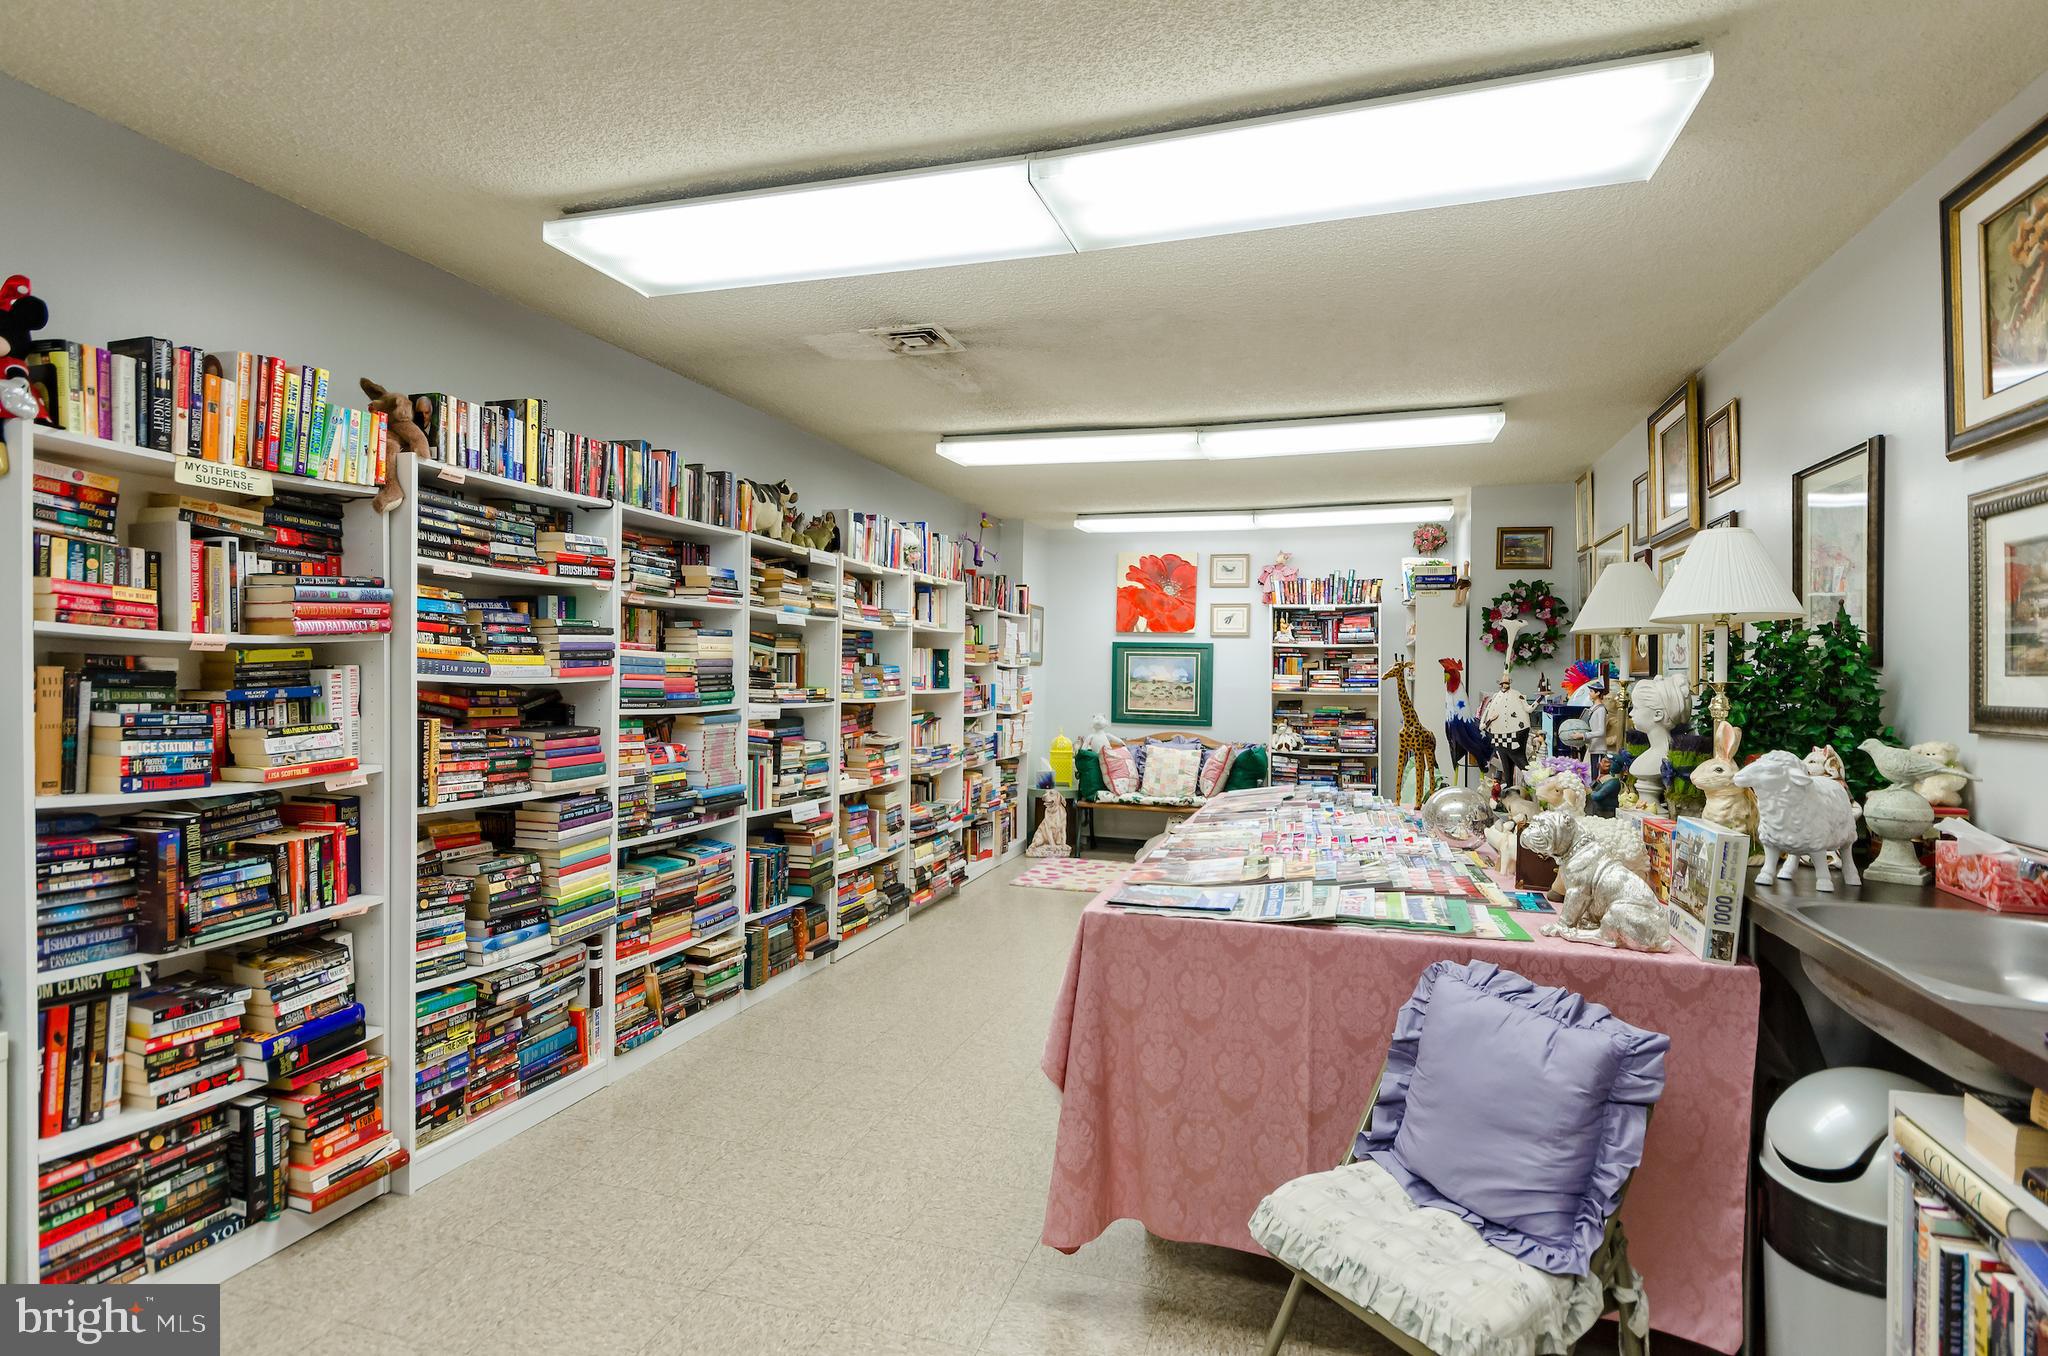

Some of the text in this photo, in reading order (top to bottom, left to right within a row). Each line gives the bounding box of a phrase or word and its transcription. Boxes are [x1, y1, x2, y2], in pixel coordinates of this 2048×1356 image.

[270, 366, 284, 437] JANET EVANOVICH
[154, 396, 165, 433] NIGHT
[284, 382, 298, 452] JANET EVANOVICH
[311, 377, 327, 454] JANET EVANOVICH
[184, 461, 247, 480] MYSTERIES
[195, 475, 254, 491] SUSPENSE
[80, 502, 109, 517] BACK FIRE
[284, 515, 322, 527] DAVID BALDACCI
[191, 553, 200, 601] DAVID BALDACCI
[559, 565, 598, 576] BRUSH BACK
[299, 590, 319, 599] DAVID
[71, 602, 100, 611] HOWARD
[297, 606, 318, 615] DAVID
[319, 606, 352, 615] BALDACCI
[362, 607, 381, 615] TARGET
[297, 620, 368, 632] DAVID BALDACCI
[441, 664, 458, 672] DEAN
[331, 673, 342, 711] MICHAEL
[139, 741, 193, 753] ICE STATION
[144, 757, 167, 766] PROTECT
[281, 768, 309, 778] SCOTTOLINE
[73, 844, 97, 857] FBI
[1713, 895, 1733, 926] 1000
[496, 924, 511, 932] SOON
[50, 933, 87, 951] SHADOW
[50, 955, 88, 968] LAYMON
[106, 970, 125, 980] DEAD
[58, 975, 103, 995] CLANCY
[112, 978, 130, 989] ALIVE
[172, 1011, 213, 1030] LABYRINTH
[284, 1008, 304, 1019] OLIVER
[445, 1041, 456, 1052] TRUE
[456, 1036, 470, 1048] CRIME
[360, 1114, 376, 1127] FURY
[1923, 1147, 1983, 1208] SONYA
[163, 1219, 186, 1235] HUSH
[159, 1218, 246, 1269] KEPNES YOU
[1951, 1262, 1962, 1311] BYRNE
